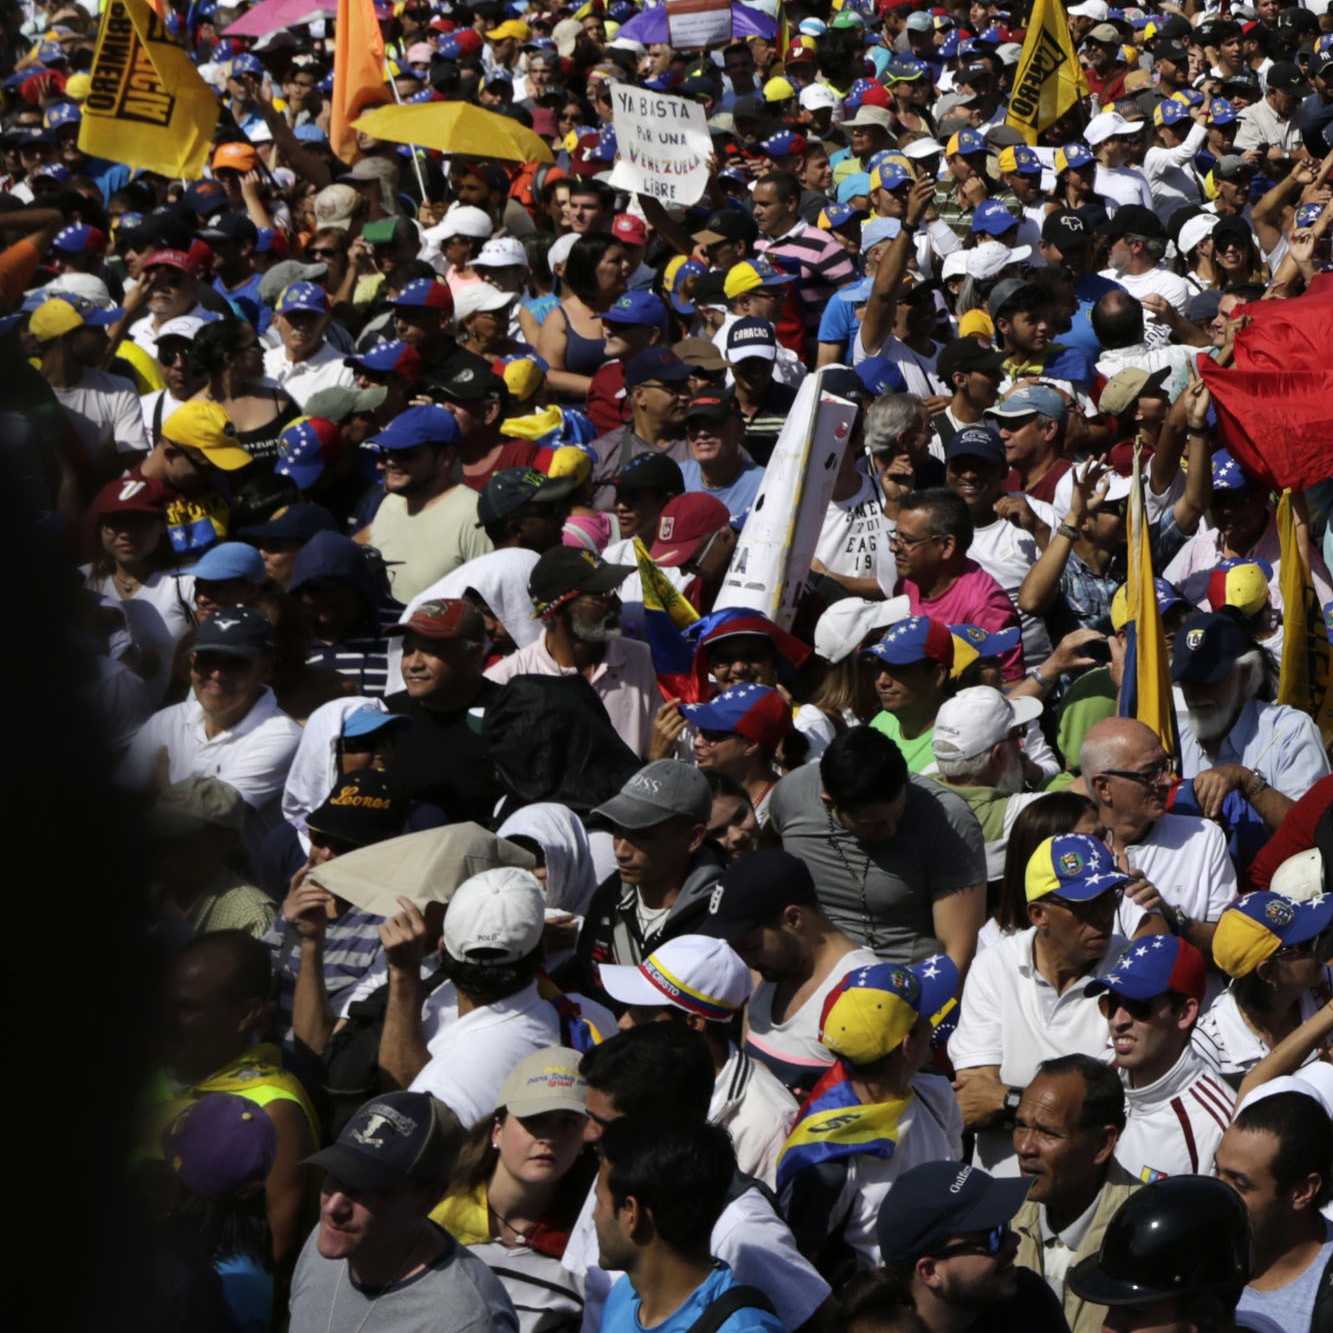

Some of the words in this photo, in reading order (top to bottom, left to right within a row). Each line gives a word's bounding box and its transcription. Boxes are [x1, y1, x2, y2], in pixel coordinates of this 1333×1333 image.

[617, 93, 637, 115] YA
[639, 98, 690, 120] BASTA
[658, 131, 688, 146] UNA
[733, 327, 770, 343] CARACAS
[330, 785, 391, 809] Leones
